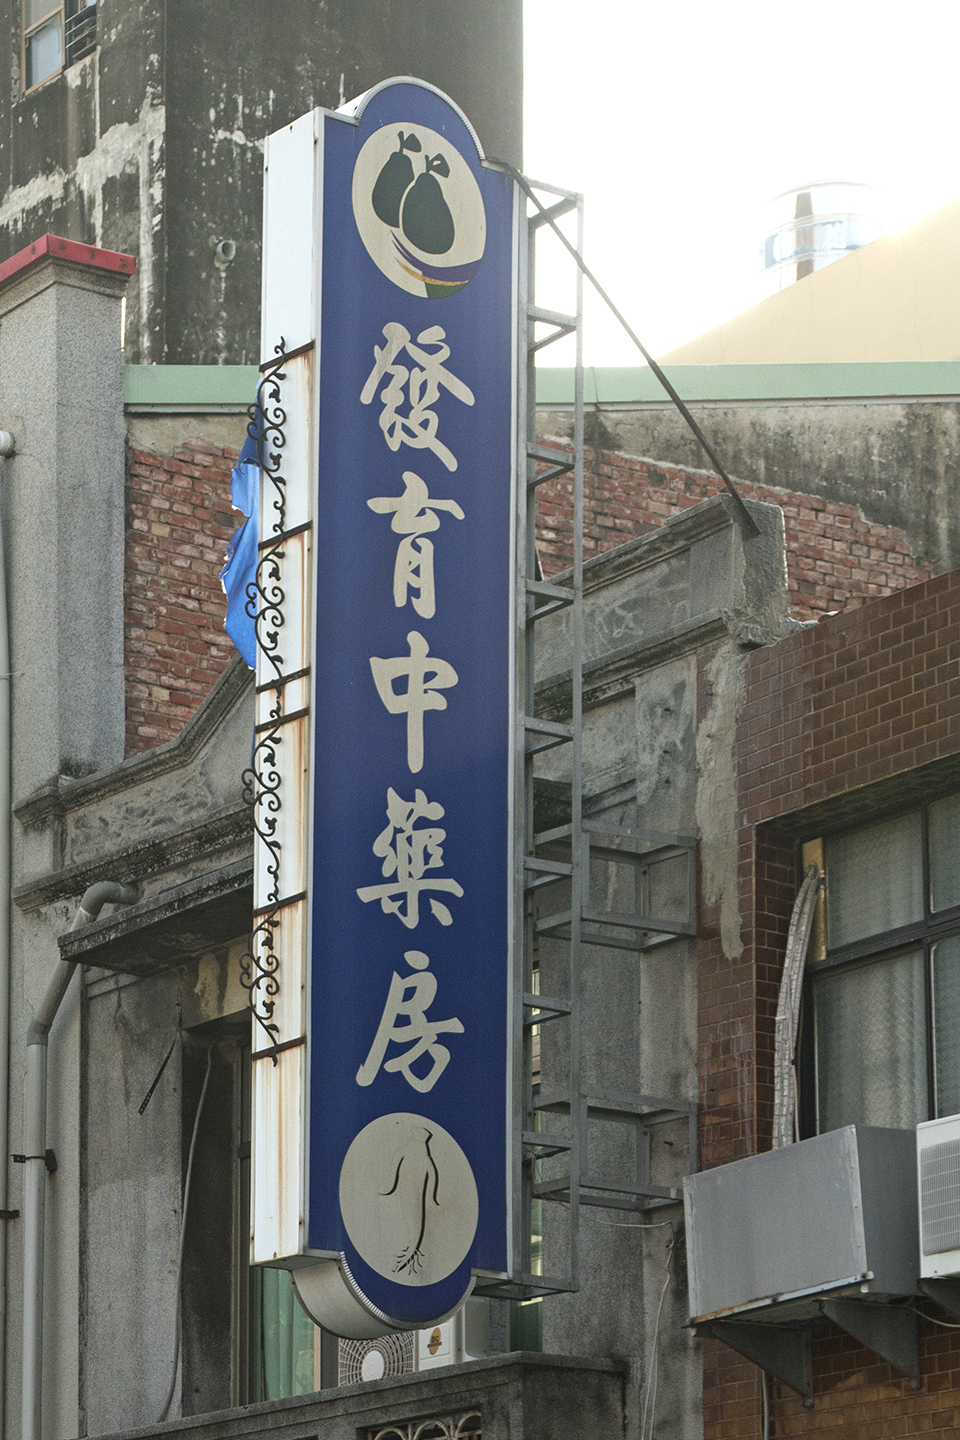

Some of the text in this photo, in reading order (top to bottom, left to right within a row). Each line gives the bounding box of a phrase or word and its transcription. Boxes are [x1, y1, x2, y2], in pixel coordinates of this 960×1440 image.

[355, 321, 477, 1095] 發育中藥房
